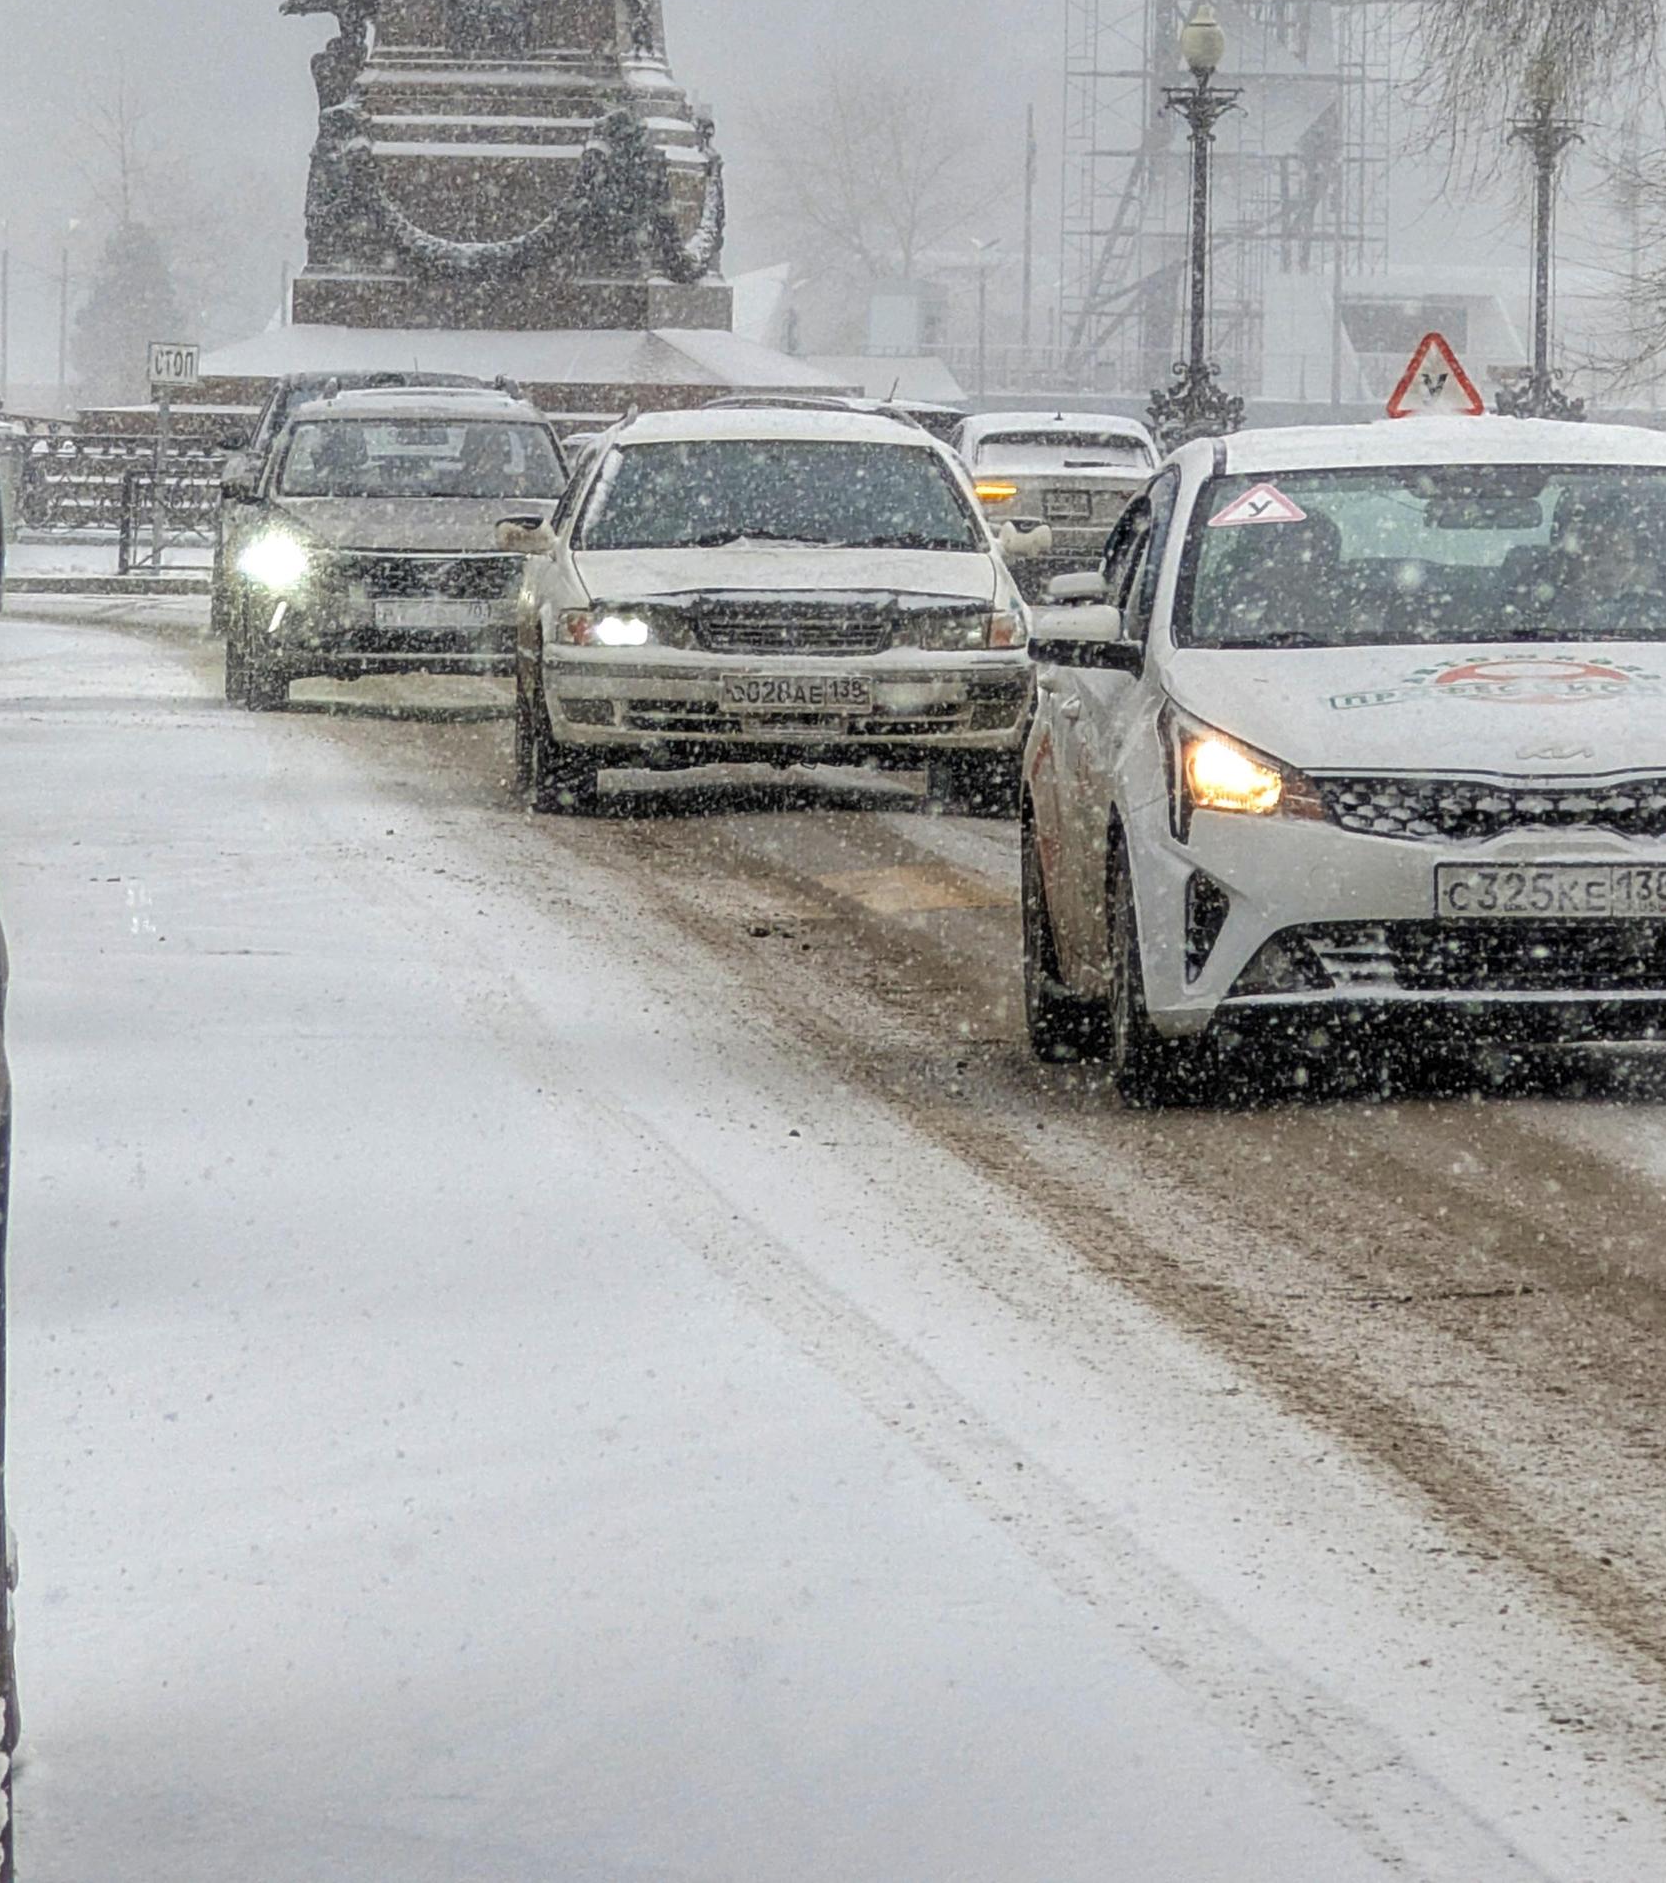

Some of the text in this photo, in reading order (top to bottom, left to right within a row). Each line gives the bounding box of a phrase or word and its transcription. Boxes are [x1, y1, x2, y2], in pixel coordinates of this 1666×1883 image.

[154, 349, 194, 378] СТОП
[1421, 372, 1449, 405] У
[1247, 499, 1274, 518] У
[1448, 872, 1607, 912] С325КЕ
